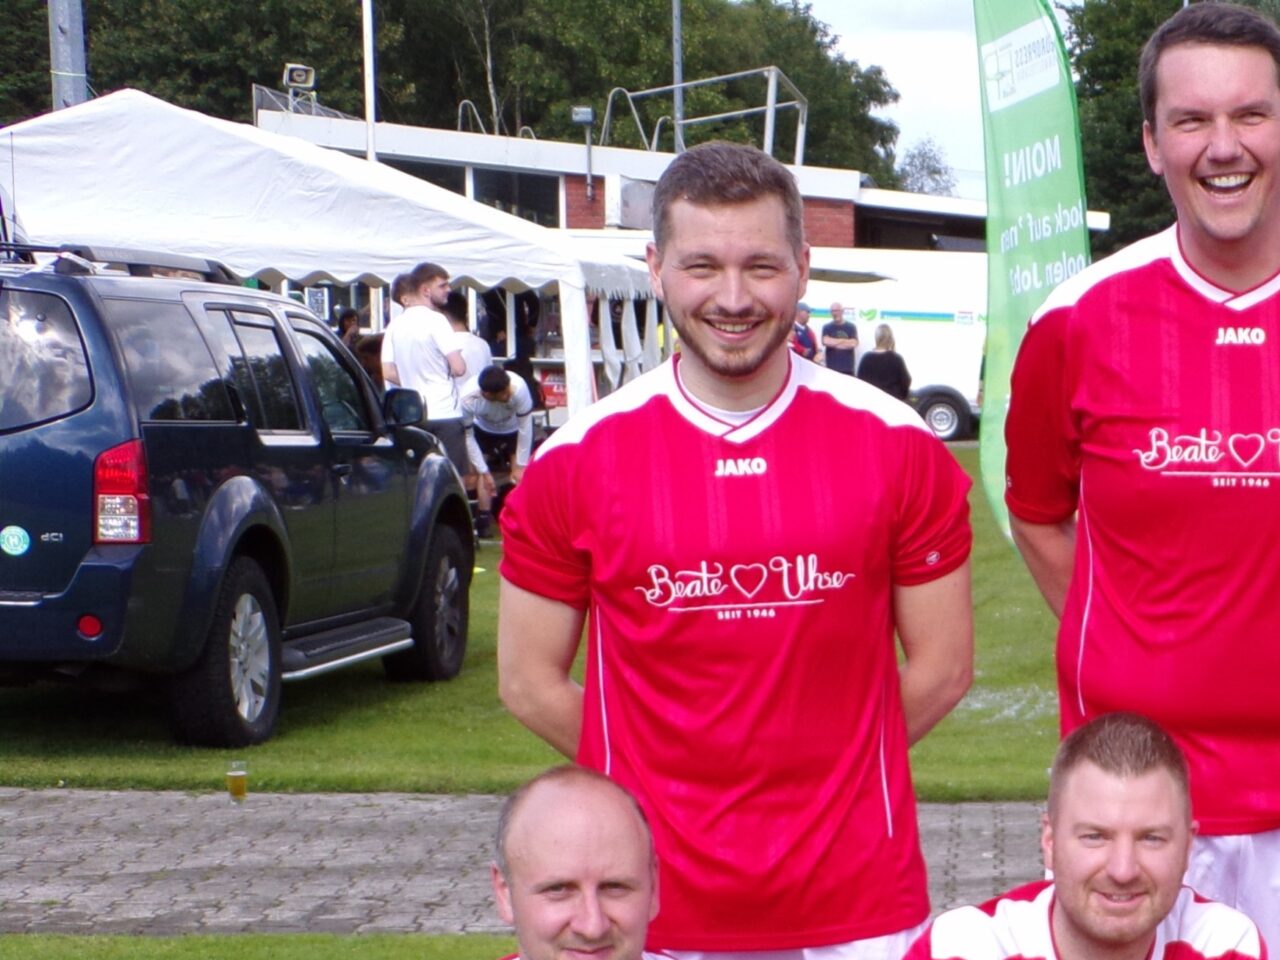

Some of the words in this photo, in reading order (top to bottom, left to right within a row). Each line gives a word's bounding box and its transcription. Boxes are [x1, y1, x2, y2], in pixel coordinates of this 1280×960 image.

[1215, 327, 1266, 345] JAKO
[1132, 427, 1225, 470] Beate
[714, 457, 767, 477] JAKO
[1213, 478, 1237, 487] SEIT
[1242, 478, 1270, 487] 1946
[634, 561, 729, 607] Beate
[768, 553, 857, 600] Uhse
[717, 610, 742, 620] SEIT
[747, 608, 776, 619] 1946
